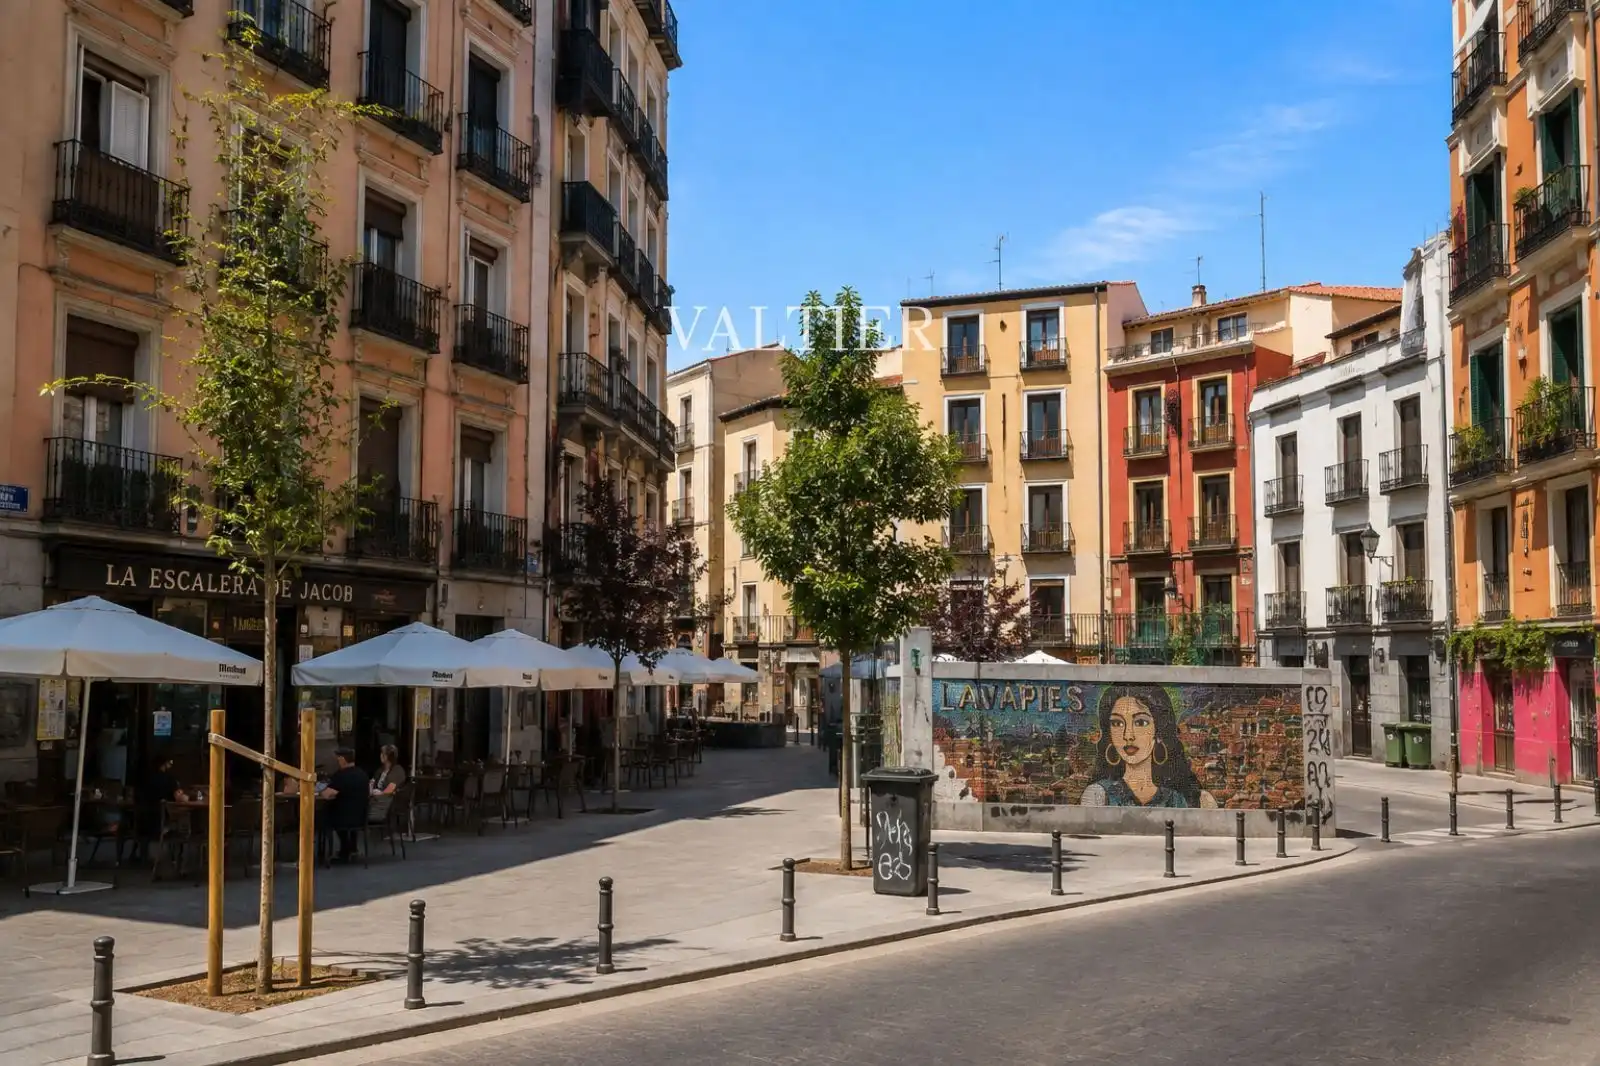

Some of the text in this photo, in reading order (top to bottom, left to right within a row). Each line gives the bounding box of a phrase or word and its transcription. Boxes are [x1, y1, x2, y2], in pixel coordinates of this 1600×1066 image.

[105, 563, 137, 587] LA
[149, 567, 259, 596] ESCALERA
[300, 581, 353, 602] JACOB
